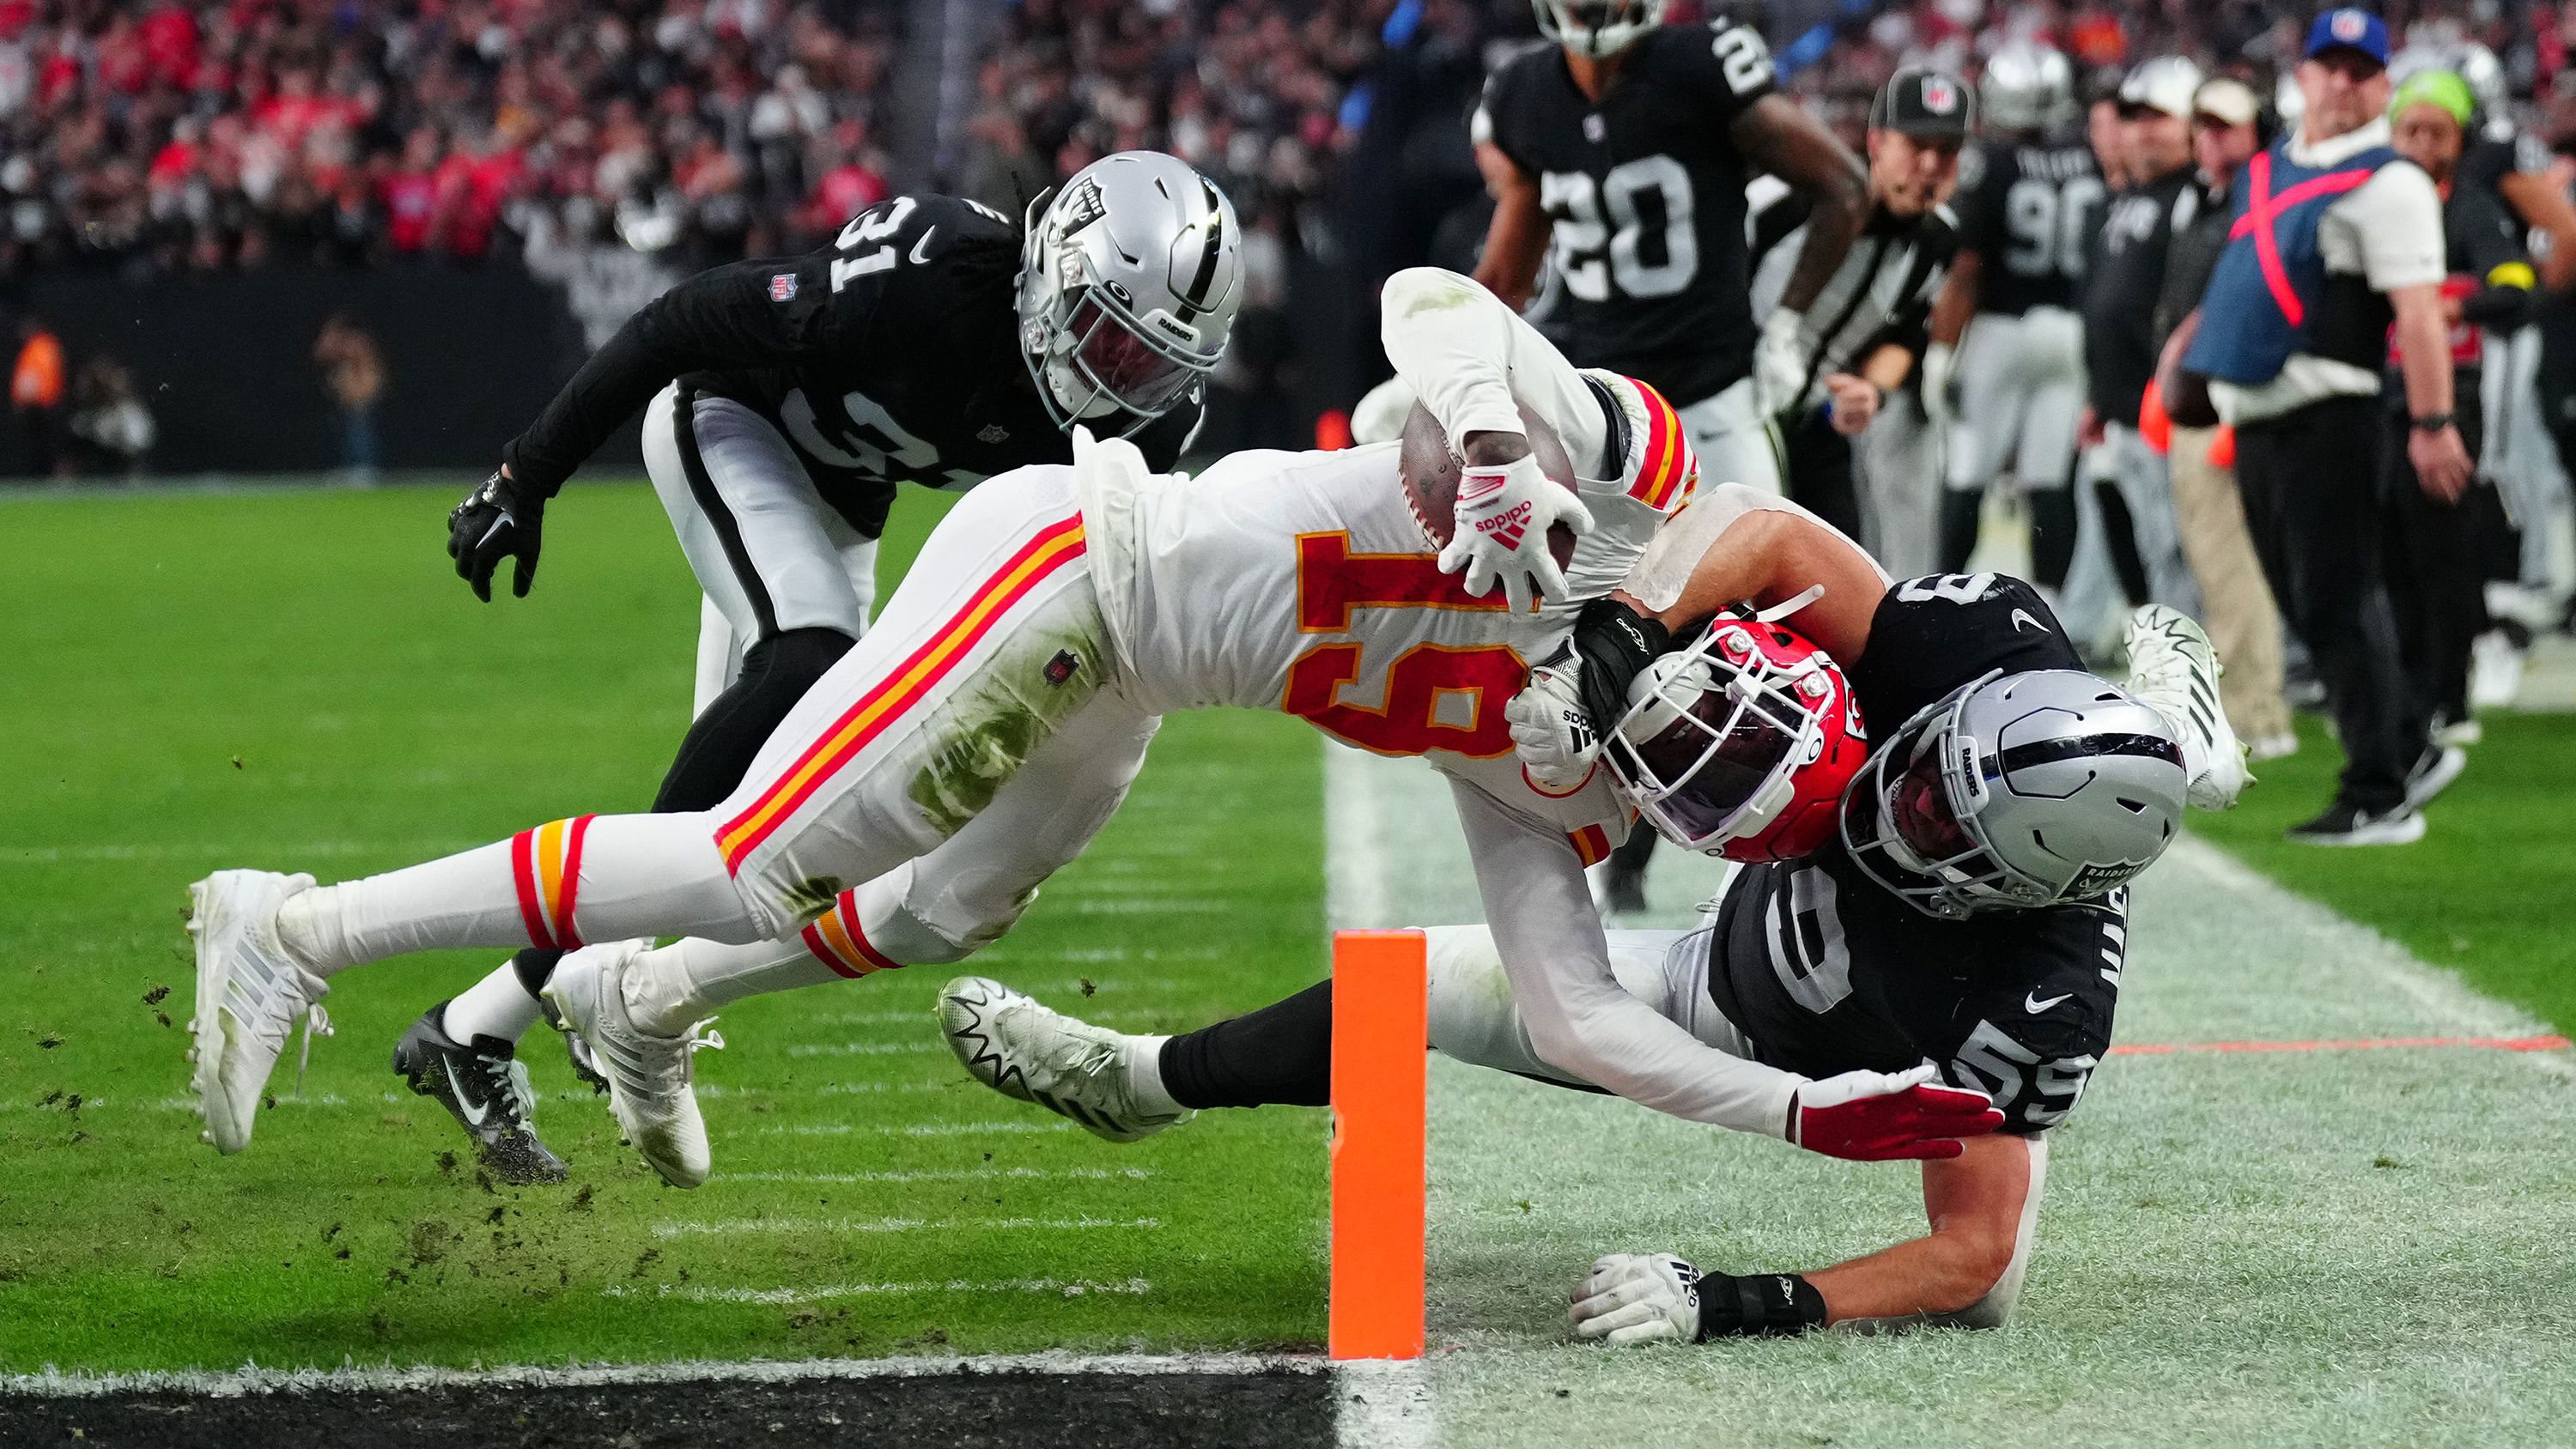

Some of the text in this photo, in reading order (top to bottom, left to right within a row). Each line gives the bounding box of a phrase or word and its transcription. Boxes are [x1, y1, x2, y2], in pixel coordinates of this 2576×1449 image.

[1082, 177, 1103, 215] RAIDERS
[1540, 155, 1698, 301] 20
[829, 196, 917, 293] 31
[1157, 318, 1194, 343] RAIDERS
[1474, 500, 1533, 532] adidas
[1280, 529, 1540, 759] 19
[1961, 747, 1980, 797] RAIDERS
[1951, 1018, 2099, 1126] 59
